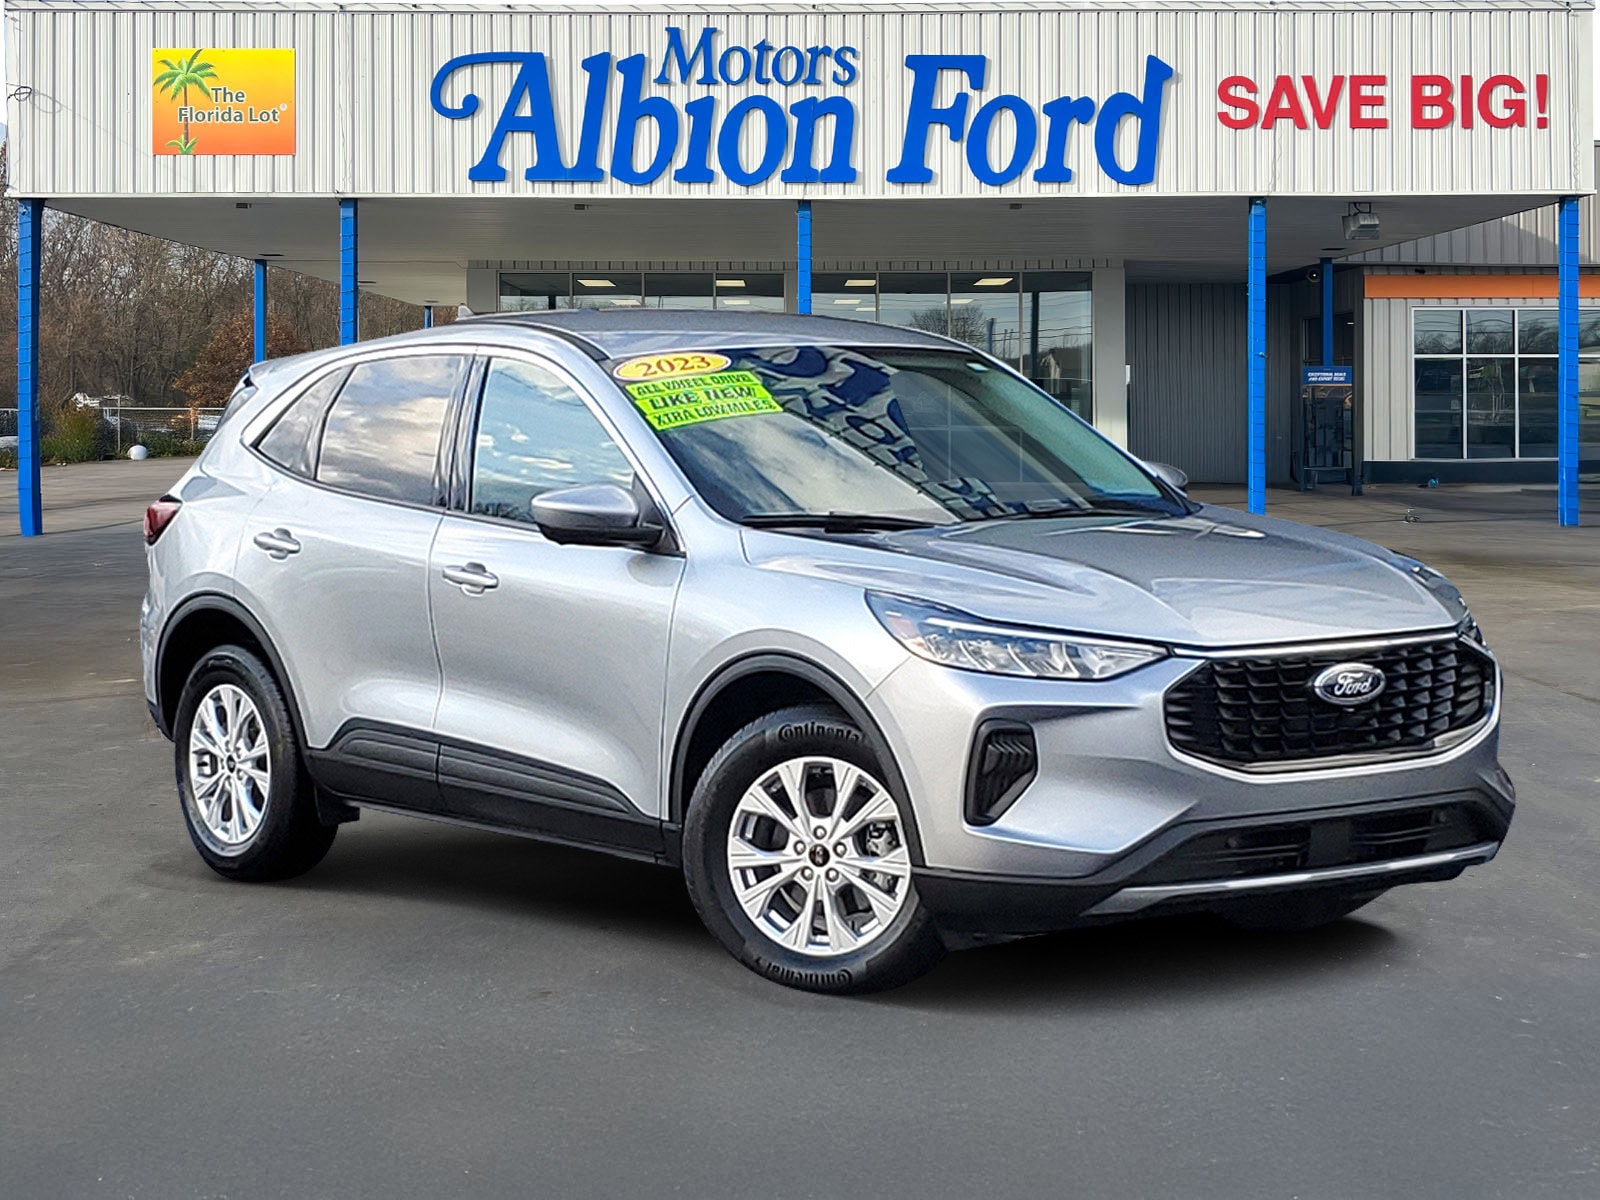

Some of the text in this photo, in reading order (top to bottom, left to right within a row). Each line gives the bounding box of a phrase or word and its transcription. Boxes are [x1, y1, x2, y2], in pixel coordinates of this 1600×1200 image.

[654, 27, 856, 85] Motors
[211, 87, 245, 102] The
[1217, 74, 1549, 129] SAVE BIG!
[178, 106, 243, 122] Florida
[431, 51, 1174, 186] Albion Ford
[635, 355, 711, 377] 2023
[636, 372, 753, 396] ALL WHEEL DRIVE
[650, 390, 699, 410] LIKE
[655, 409, 694, 426] XTRA
[1334, 672, 1373, 696] Ford
